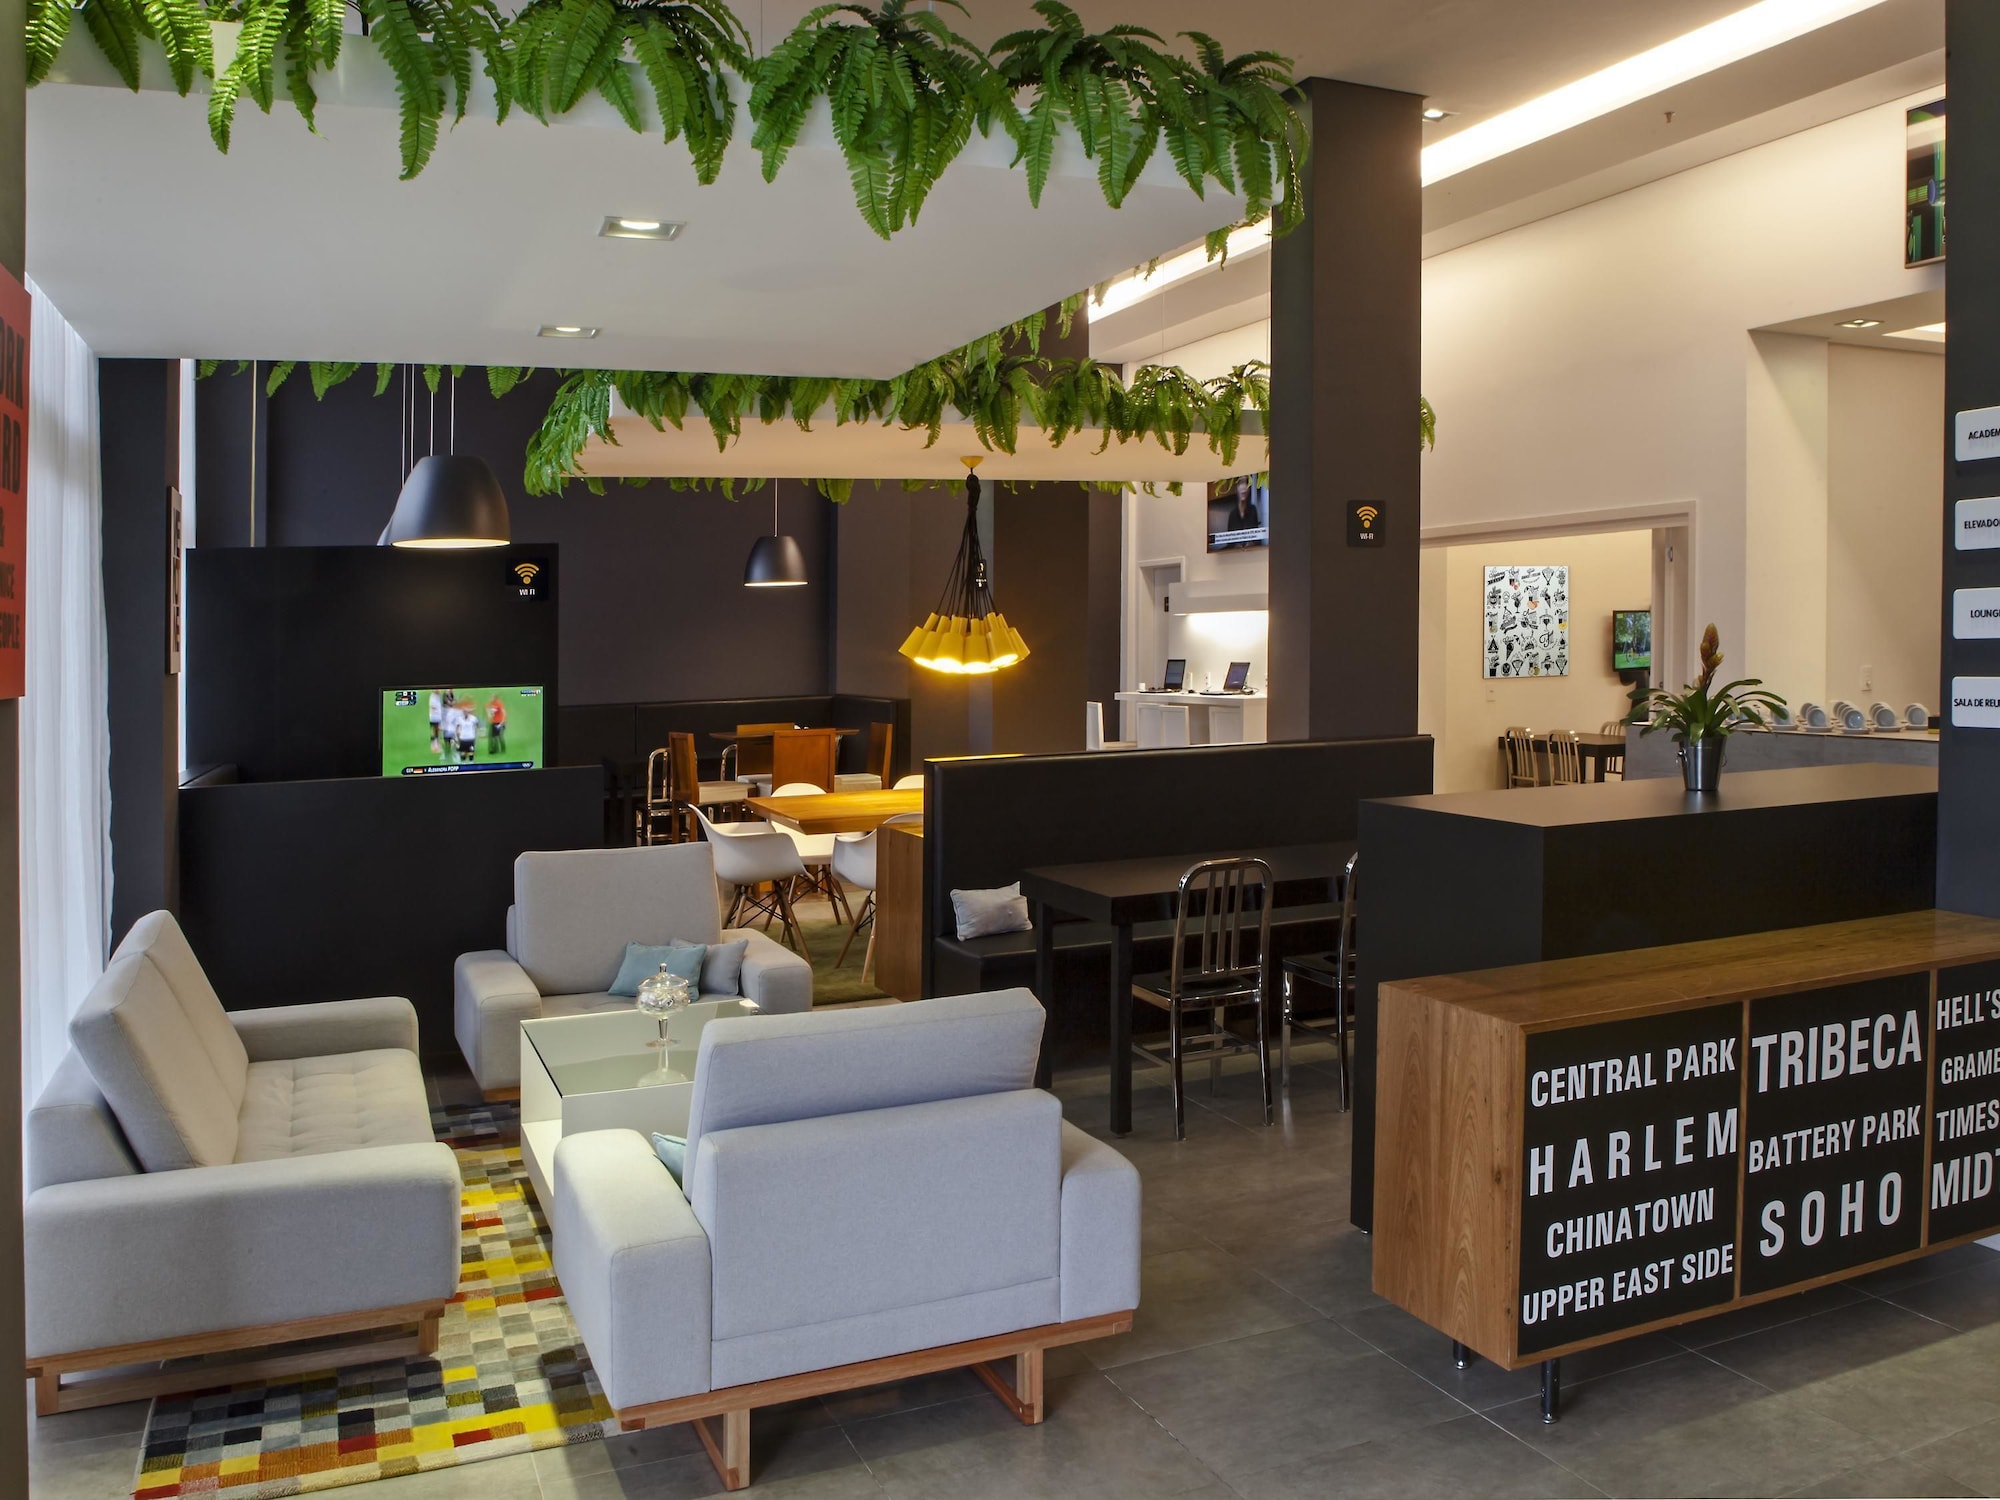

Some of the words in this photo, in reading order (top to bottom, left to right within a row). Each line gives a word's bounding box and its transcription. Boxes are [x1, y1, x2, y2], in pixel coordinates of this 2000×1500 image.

[1964, 518, 2000, 529] ELEVADO
[1954, 698, 1972, 707] SALA
[1974, 699, 1984, 707] DE
[1936, 988, 2000, 1031] HELL'S
[1531, 1052, 1657, 1108] CENTRAL
[1666, 1037, 1736, 1083] PARK
[1751, 1009, 1922, 1093] TRIBECA
[1529, 1107, 1738, 1197] HARLEM
[1748, 1118, 1856, 1174] BATTERY
[1862, 1104, 1921, 1148] PARK
[1936, 1099, 2000, 1142] TIMES
[1546, 1187, 1714, 1258] CHINATOWN
[1759, 1171, 1902, 1257] SOHO
[1522, 1276, 1605, 1325] UPPER
[1612, 1258, 1675, 1303] EAST
[1681, 1243, 1734, 1285] SIDE
